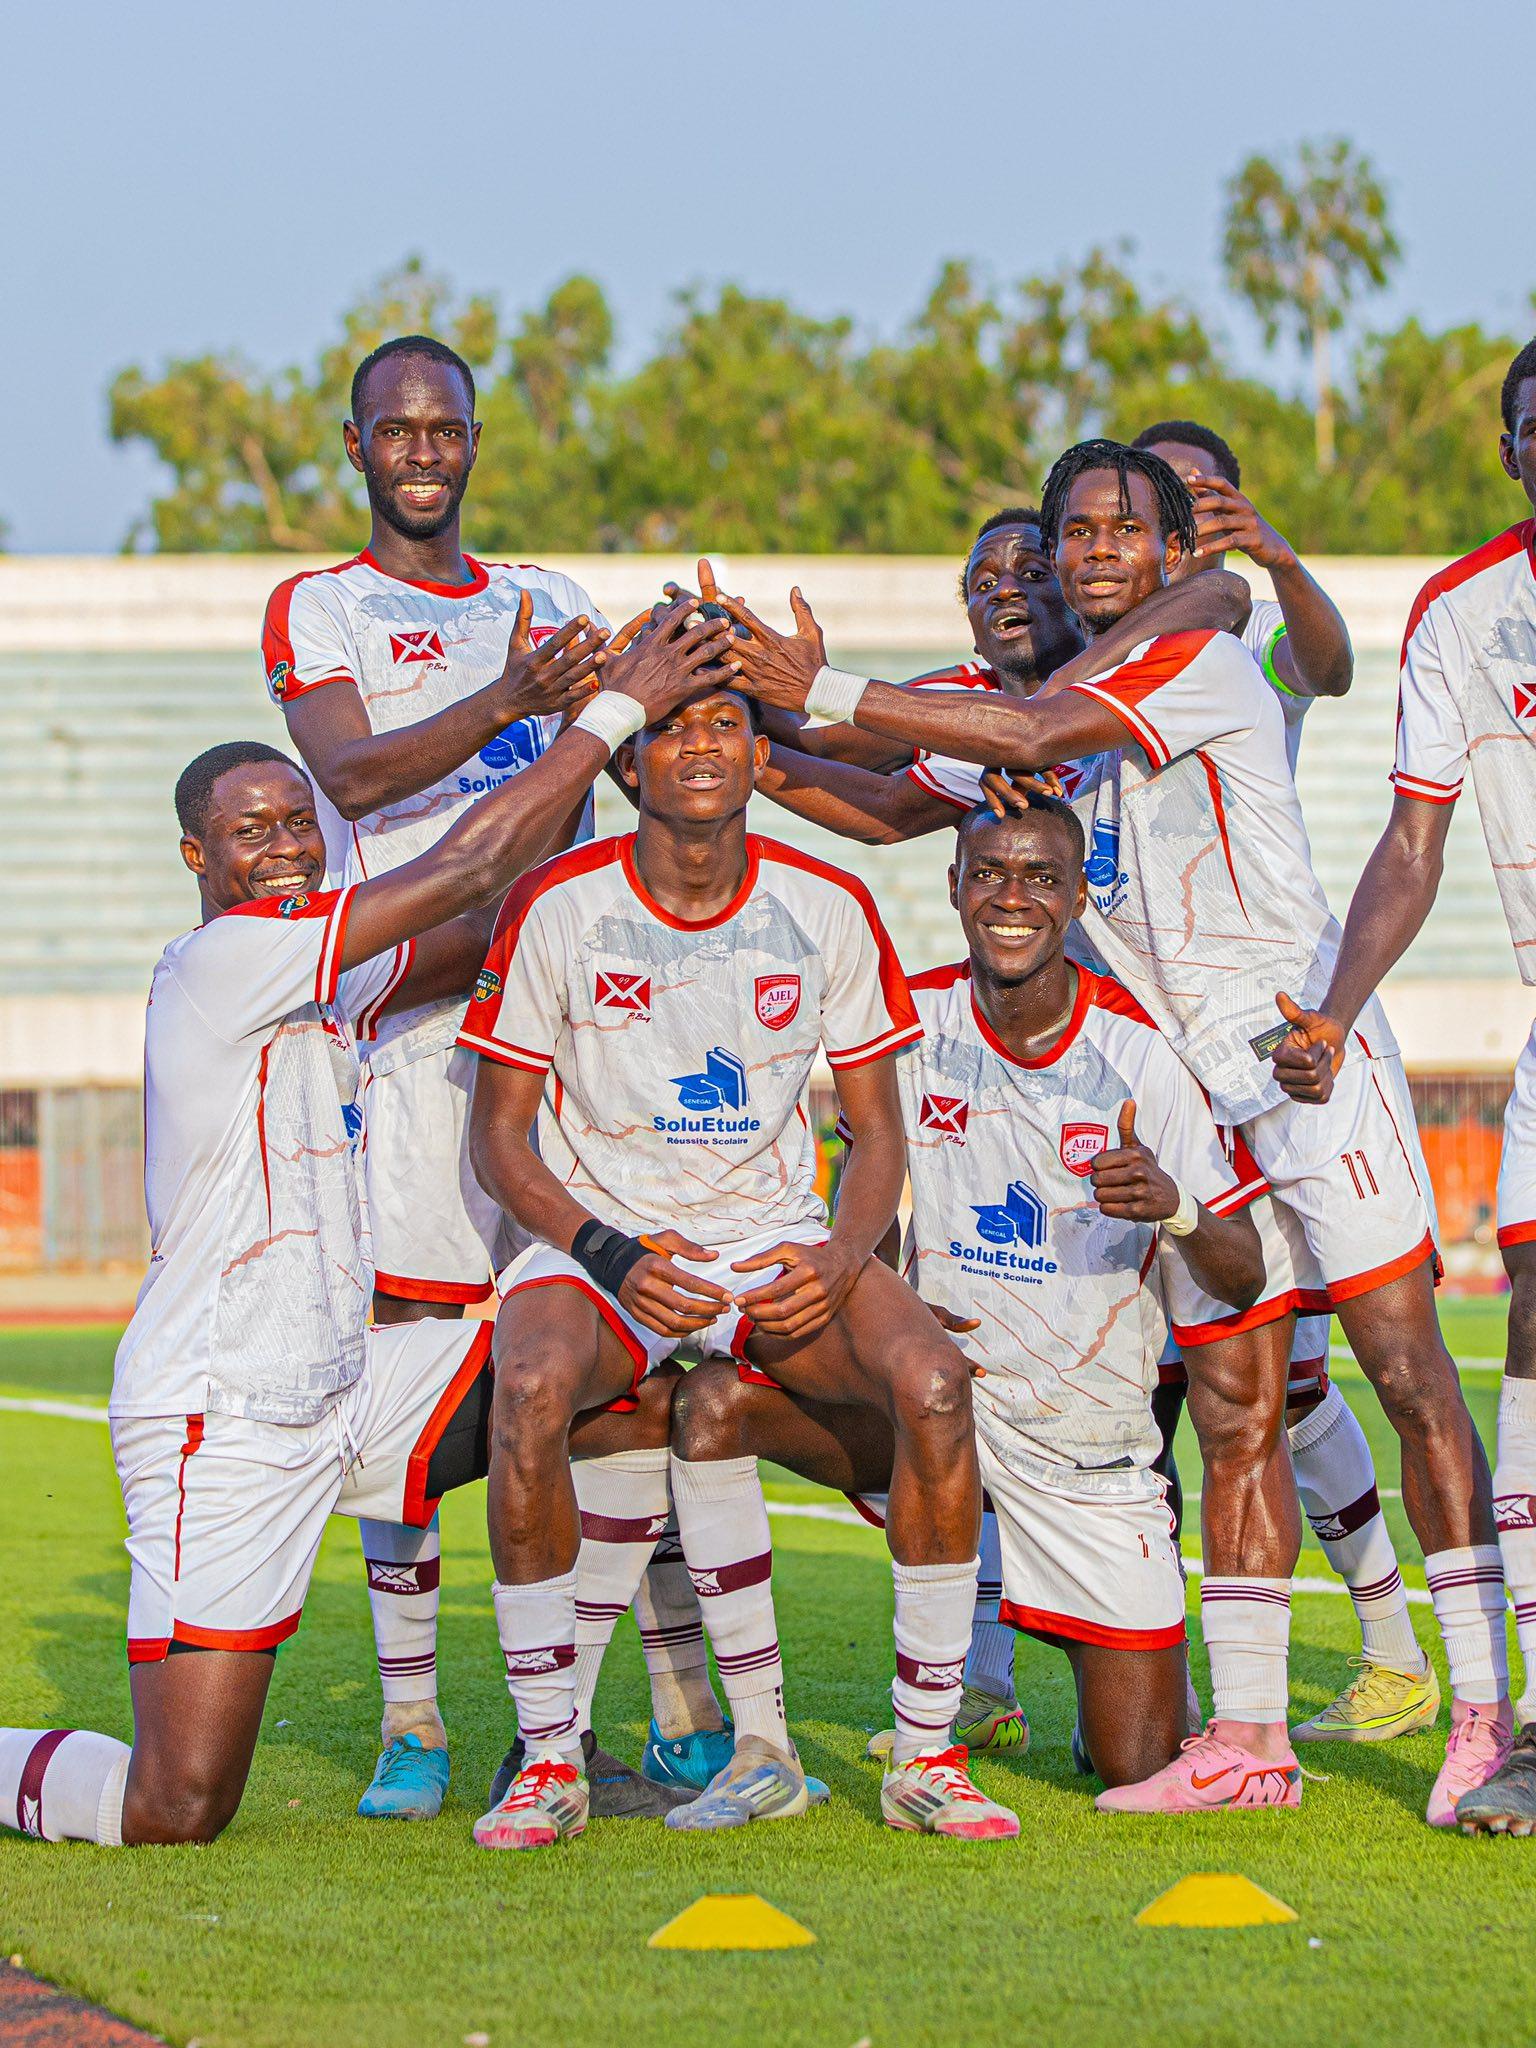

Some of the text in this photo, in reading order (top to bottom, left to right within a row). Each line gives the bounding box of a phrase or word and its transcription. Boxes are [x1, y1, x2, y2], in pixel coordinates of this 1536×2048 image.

[767, 989, 794, 1002] AJEL
[653, 1115, 760, 1133] SoluEtude
[666, 1136, 749, 1145] Réussite Scolaire
[1072, 1138, 1099, 1150] AJEL
[1340, 1149, 1380, 1200] 11
[949, 1241, 1058, 1274] SoluEtude
[961, 1264, 1043, 1285] Réussite Scolaire
